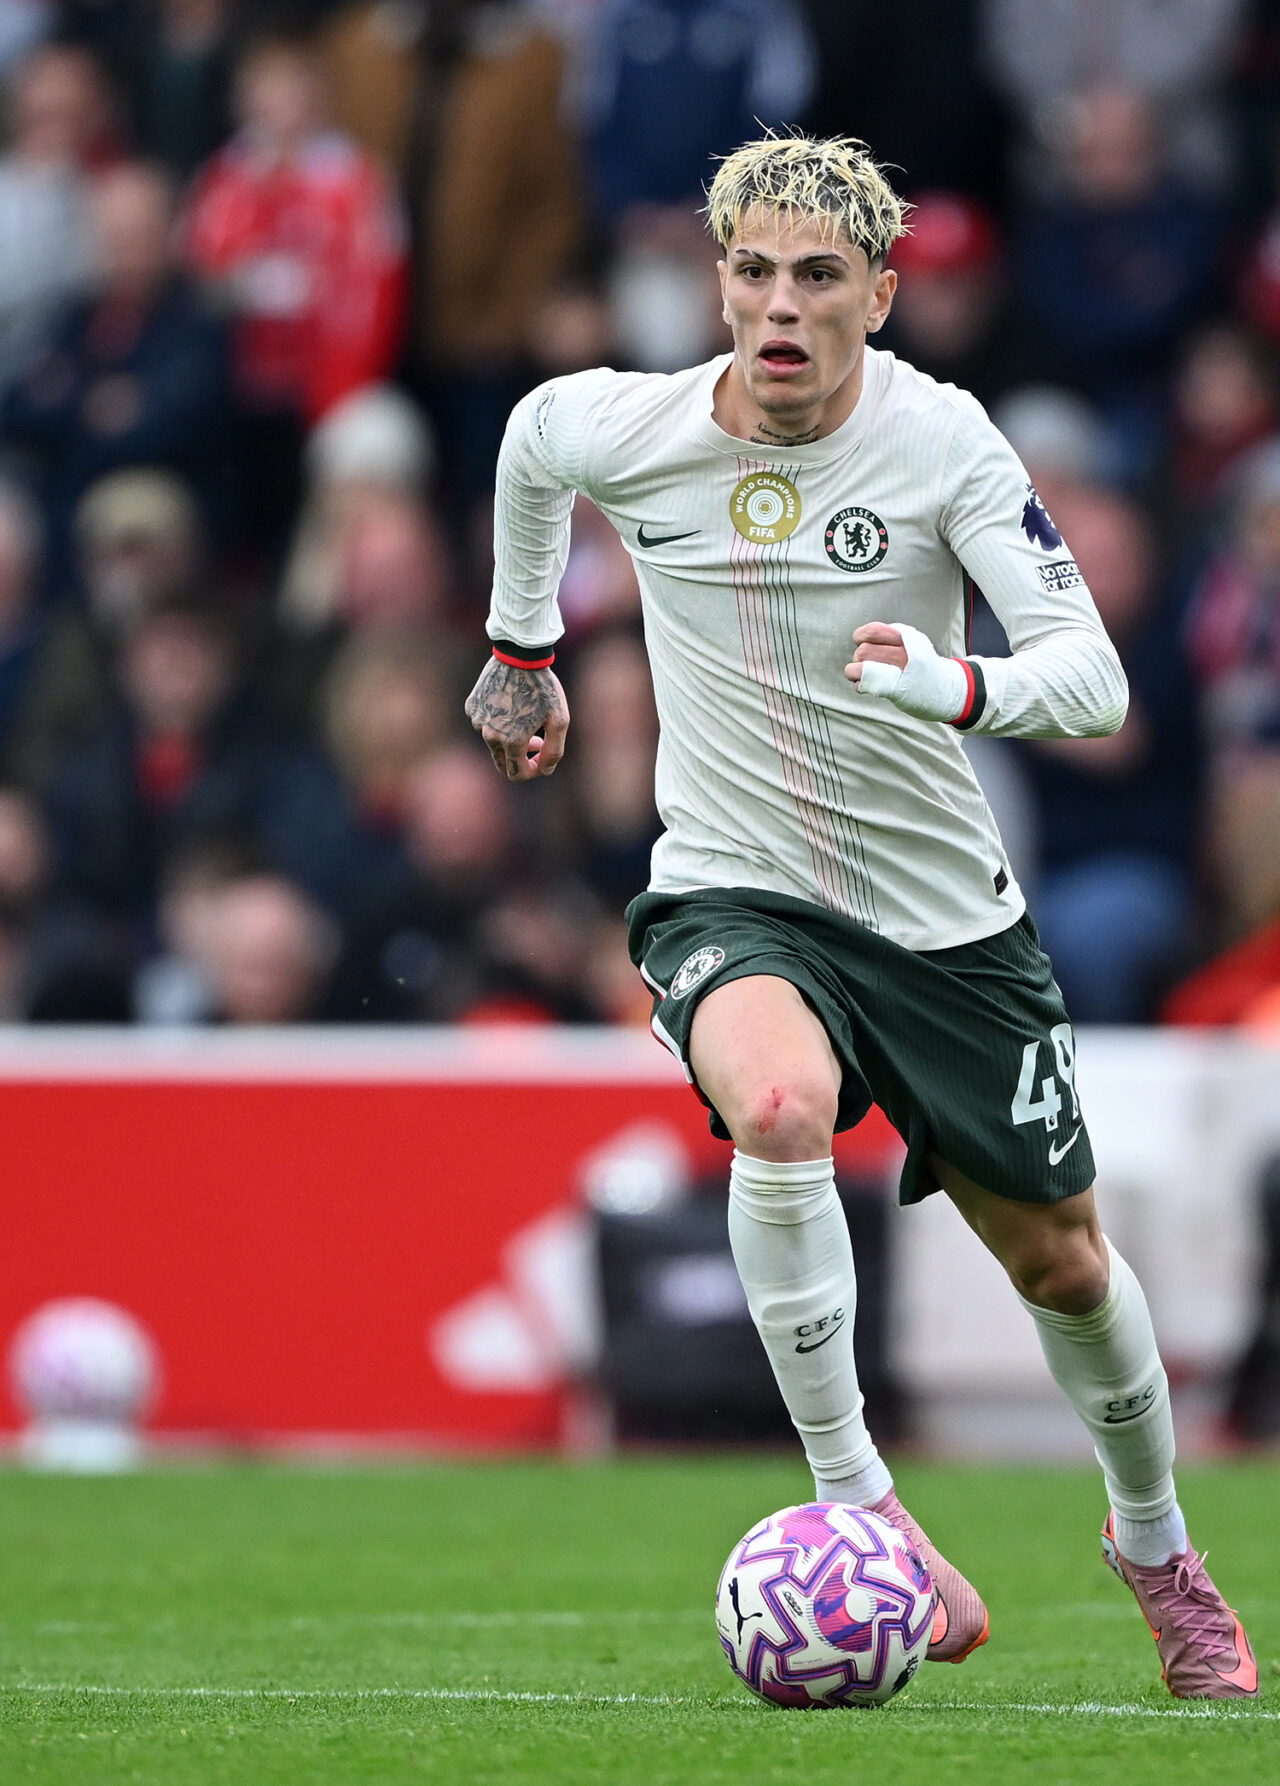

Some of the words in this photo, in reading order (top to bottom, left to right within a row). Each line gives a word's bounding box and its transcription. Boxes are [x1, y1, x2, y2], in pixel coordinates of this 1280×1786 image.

[736, 481, 755, 513] WORLD
[757, 478, 795, 519] CHAMPIONS
[833, 508, 876, 523] CHELSEA
[748, 526, 776, 539] FIFA
[835, 558, 865, 571] FOOTBALL
[866, 557, 880, 568] CLUB
[1035, 566, 1057, 580] No
[1011, 1022, 1079, 1133] 49
[794, 1307, 845, 1337] CFC
[1106, 1384, 1155, 1412] CFC
